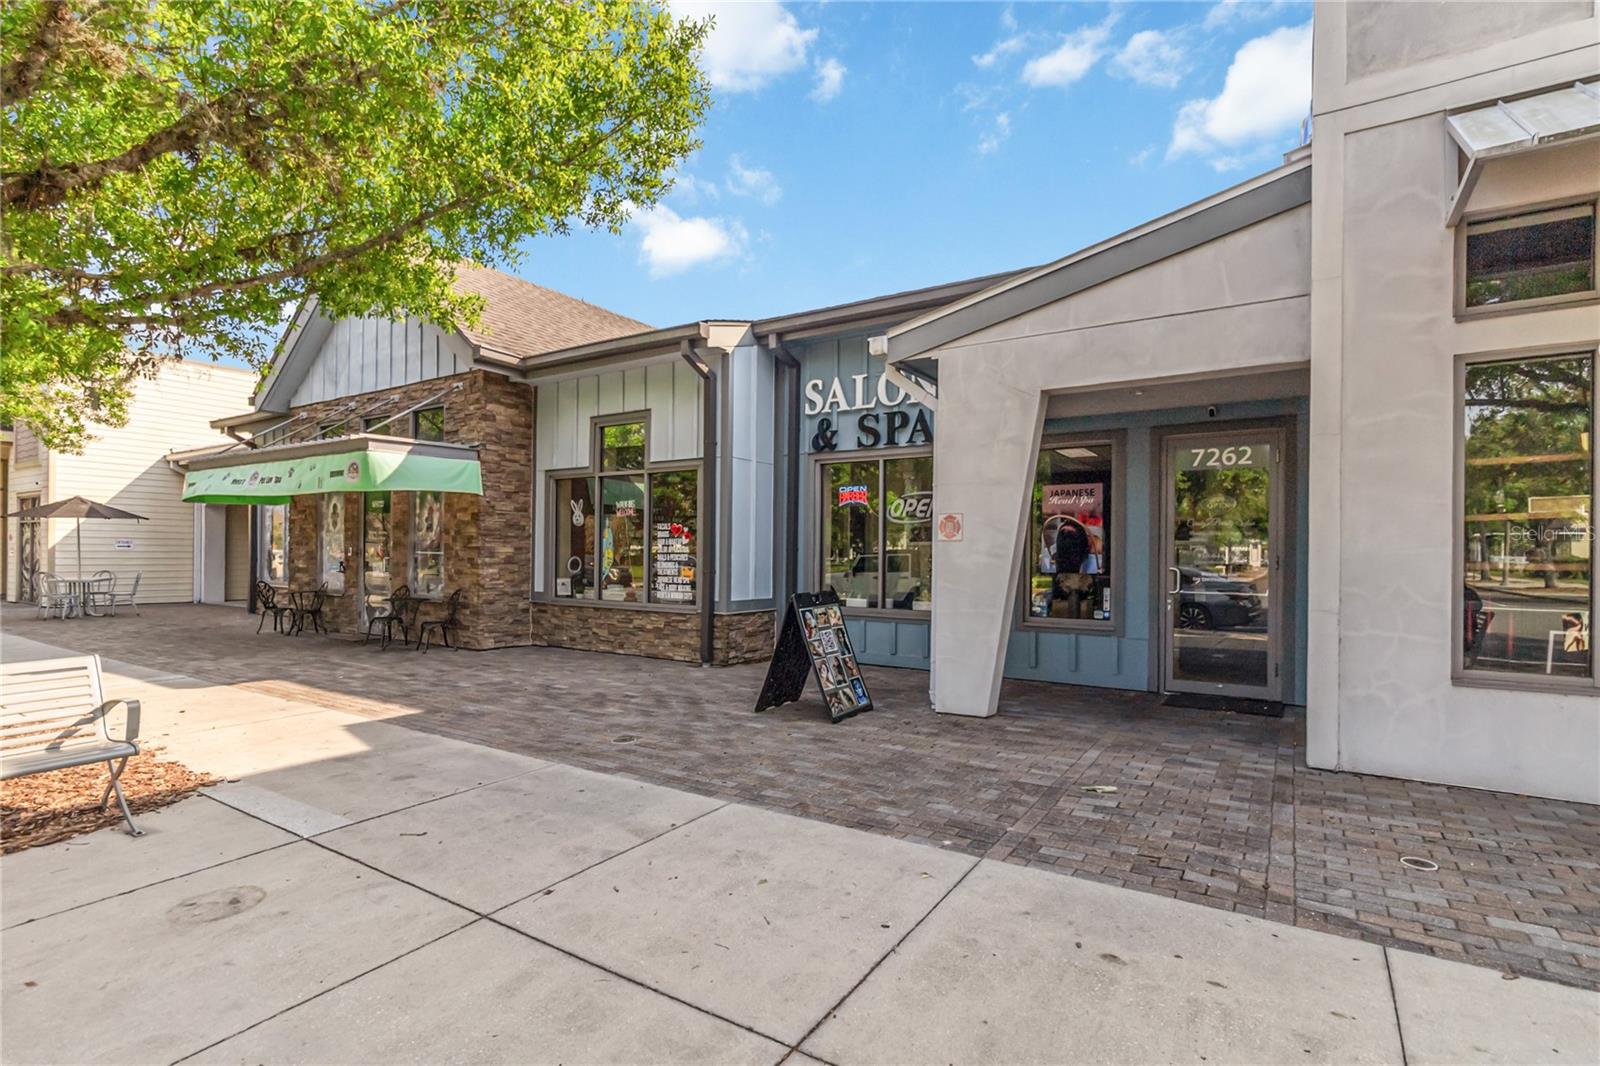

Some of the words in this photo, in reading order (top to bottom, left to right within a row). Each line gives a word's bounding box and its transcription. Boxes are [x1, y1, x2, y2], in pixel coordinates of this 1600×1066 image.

[811, 417, 838, 451] &
[857, 408, 933, 448] SPA
[1191, 446, 1253, 468] 7262
[1048, 495, 1077, 505] Head
[1075, 496, 1094, 507] Spa
[1049, 488, 1096, 498] JAPANESE
